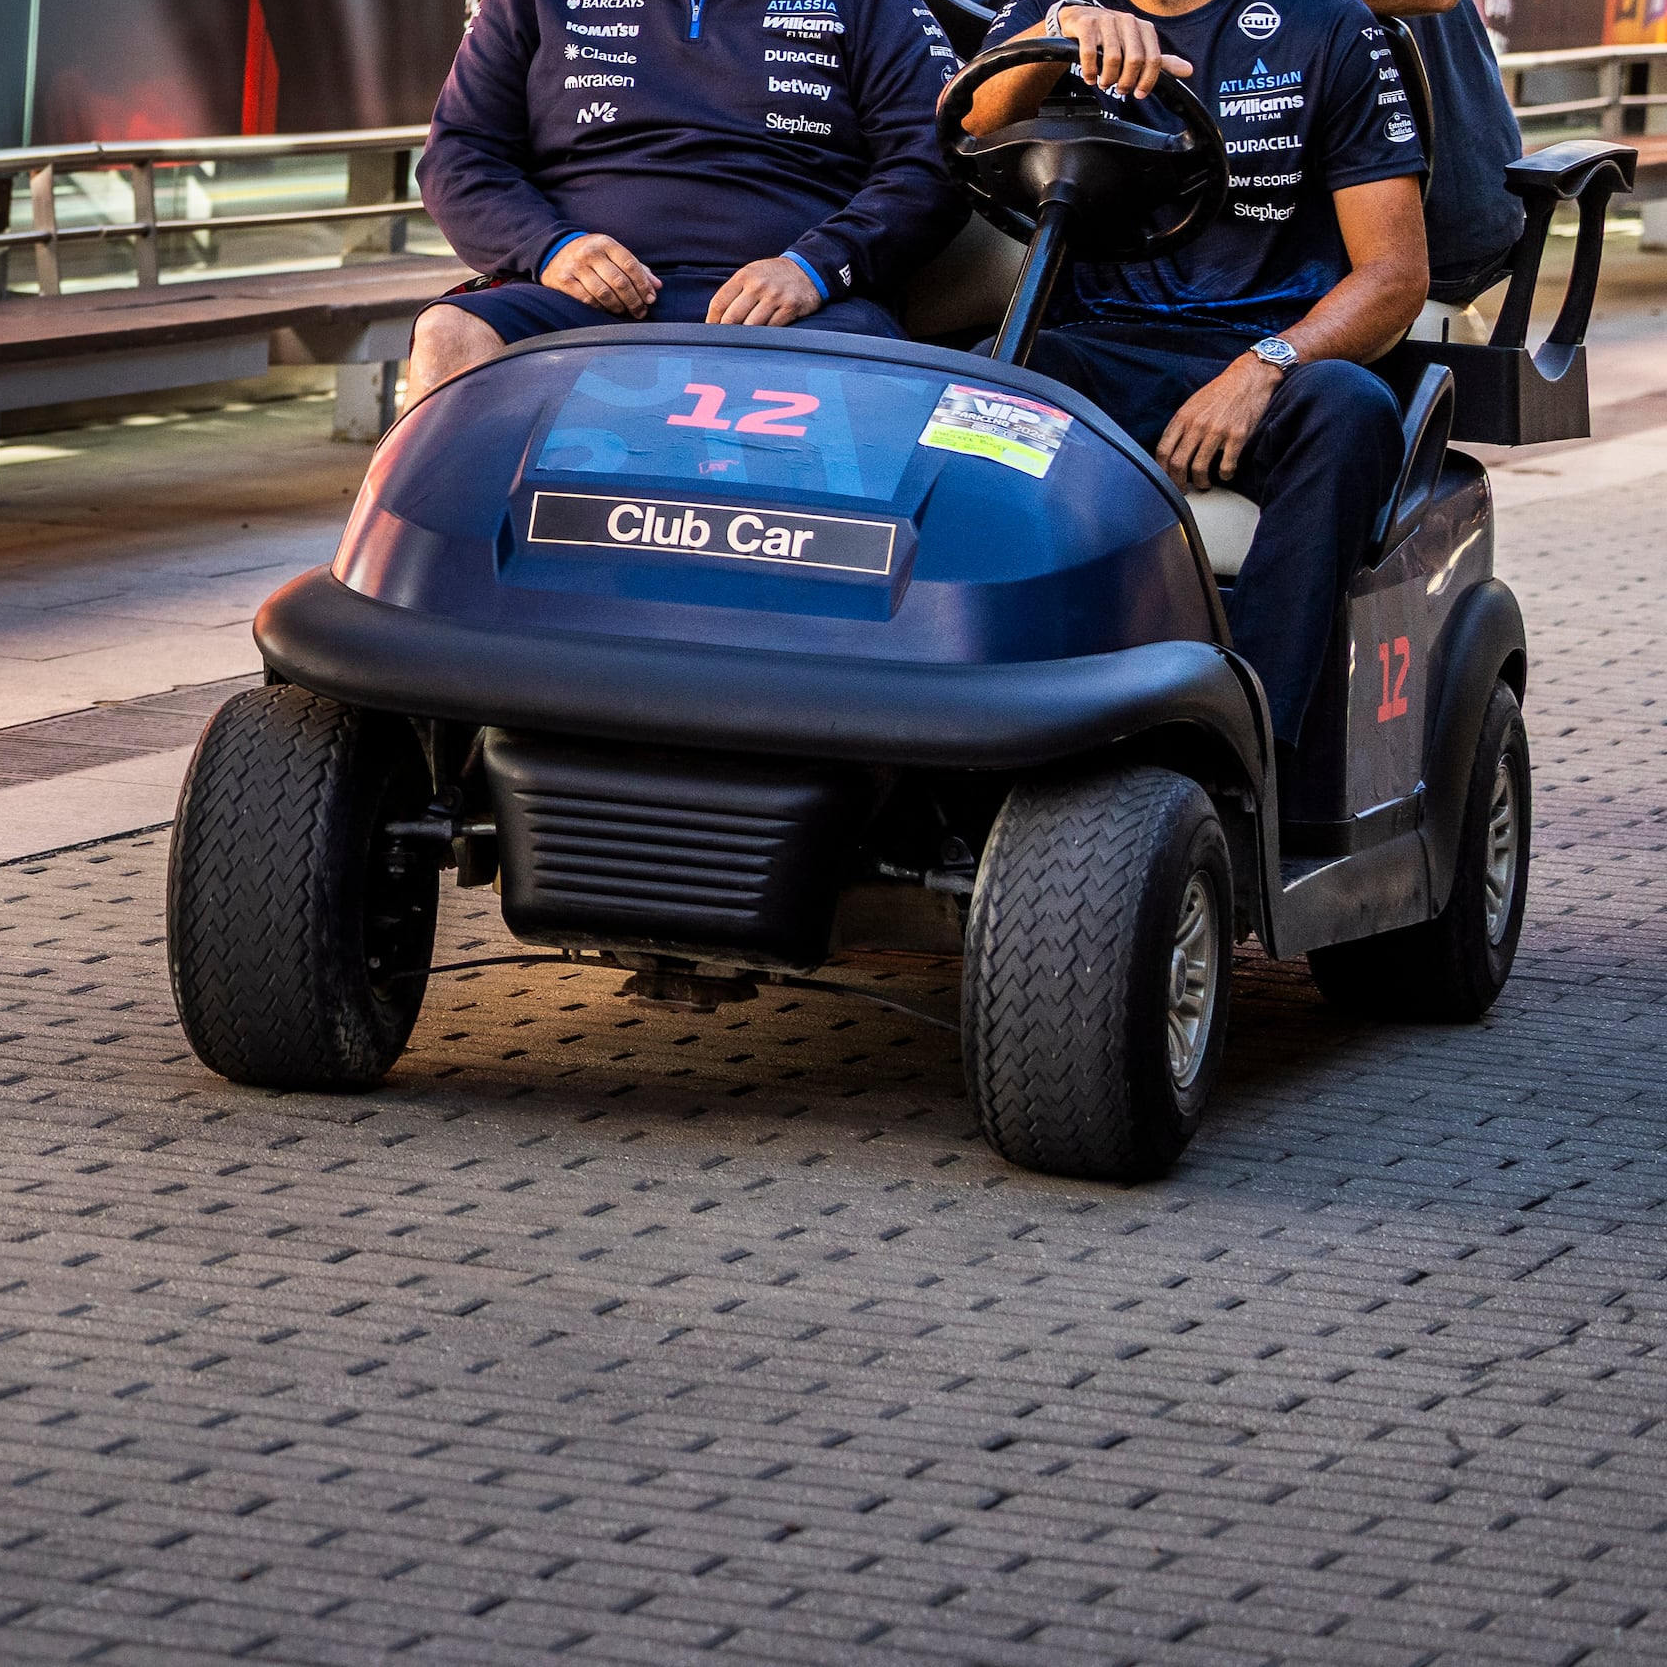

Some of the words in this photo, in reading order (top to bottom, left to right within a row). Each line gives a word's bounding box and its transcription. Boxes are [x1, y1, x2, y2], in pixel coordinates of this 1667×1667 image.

[565, 20, 640, 38] KOMATSU
[762, 15, 846, 35] Williams
[1241, 15, 1278, 27] Gulf
[798, 31, 822, 40] TEAM
[580, 46, 638, 64] Claude
[764, 49, 840, 68] DURACELL
[577, 73, 635, 89] kraken
[768, 75, 832, 101] betway
[1218, 70, 1302, 93] ATLASSIAN
[1219, 94, 1304, 117] Williams
[765, 112, 832, 135] Stephens
[1245, 114, 1255, 123] F1
[1257, 112, 1282, 122] TEAM
[1387, 119, 1412, 130] Estrella
[1225, 134, 1303, 154] DURACELL
[1252, 170, 1303, 187] SCORES
[666, 382, 821, 438] 12
[973, 398, 1041, 424] VIP
[950, 410, 1011, 428] PARKING
[1012, 423, 1047, 440] 2026
[606, 502, 713, 550] Club
[725, 513, 815, 559] Car
[1376, 635, 1412, 725] 12
